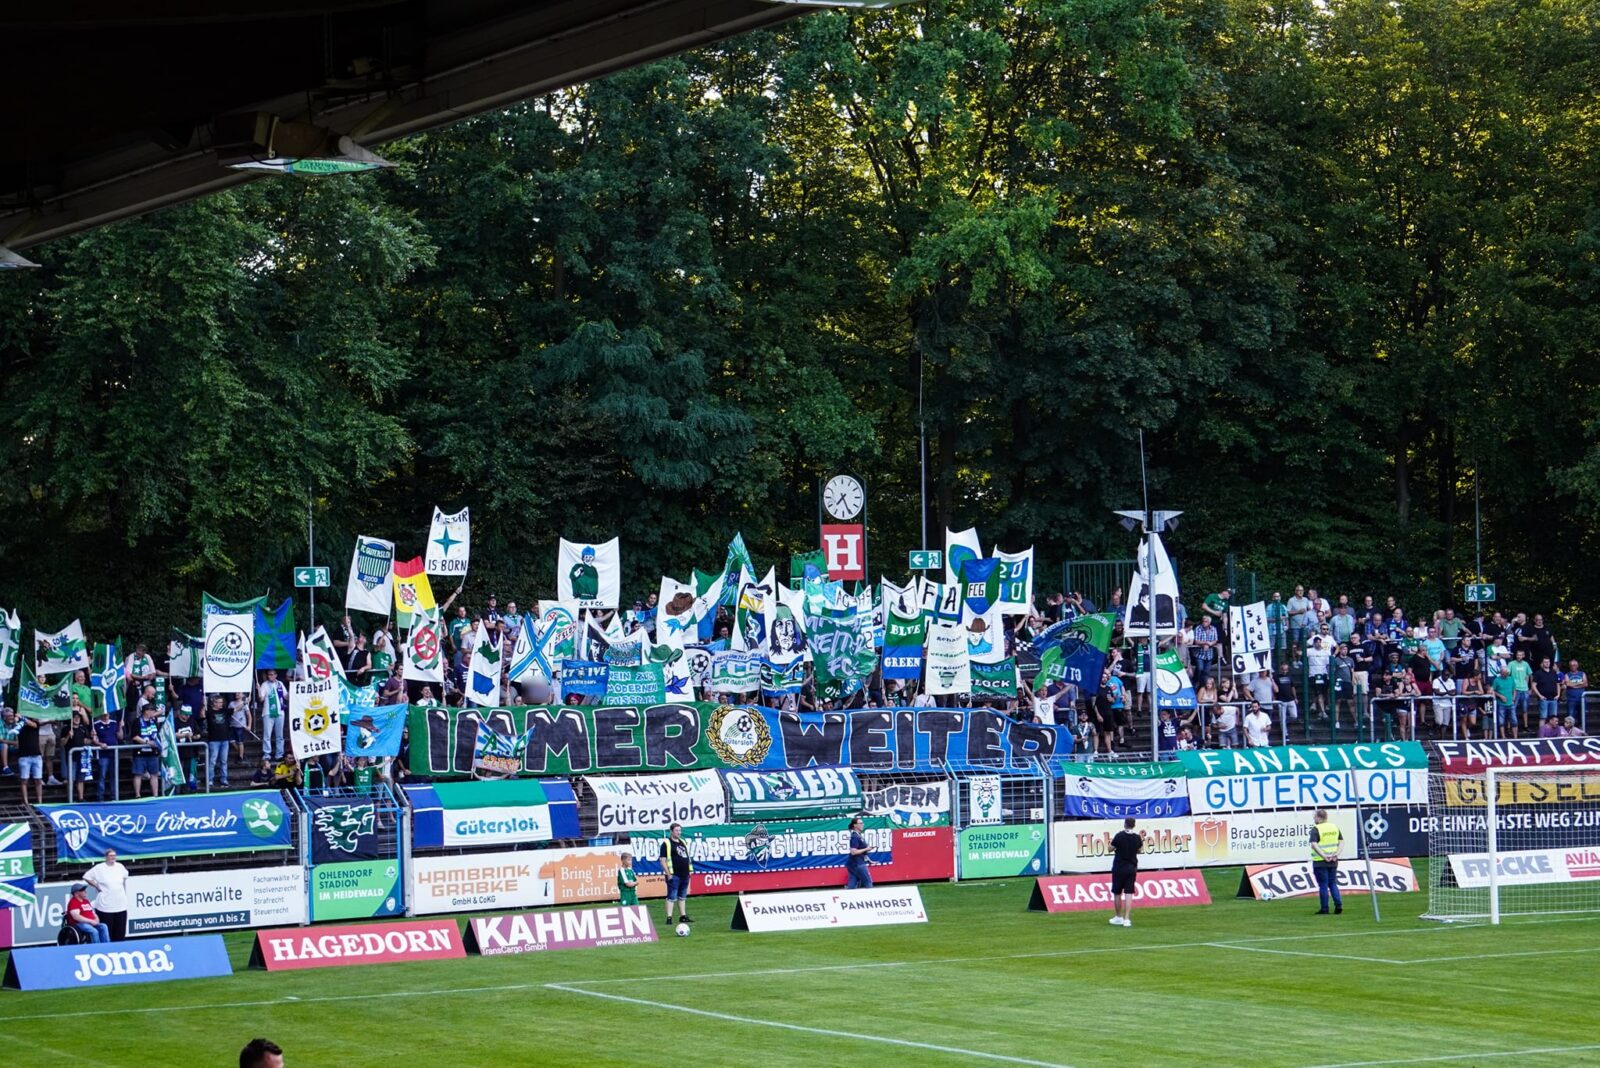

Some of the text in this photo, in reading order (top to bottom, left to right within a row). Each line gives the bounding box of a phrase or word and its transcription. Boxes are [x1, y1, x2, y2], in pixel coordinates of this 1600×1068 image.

[824, 534, 862, 570] H
[428, 559, 467, 572] IS BORN
[968, 584, 984, 596] FCG
[884, 656, 921, 668] GREEN
[426, 705, 1058, 773] IMMER WEITER
[1200, 743, 1406, 775] FANATICS
[1438, 737, 1600, 766] FANATICS
[1085, 764, 1164, 776] Fussball
[624, 780, 692, 796] Aktive
[794, 767, 859, 800] LEBT
[1206, 770, 1410, 809] GÜTERSLOH
[600, 798, 724, 826] Gütersloher
[1082, 802, 1173, 816] Gütersloh
[88, 812, 147, 837] 4830
[156, 809, 238, 833] Gütersloh
[456, 816, 539, 836] Gütersloh
[1410, 816, 1438, 833] DER
[1442, 814, 1532, 832] EINFAHSTE
[1535, 812, 1570, 828] WEG
[968, 832, 1020, 842] OHLENDORF
[1231, 824, 1315, 840] BrauSpezialitä
[630, 829, 892, 862] VOÄRTS GÜTERSOH
[968, 840, 1006, 850] STADION
[1231, 840, 1296, 850] Privat-Brauerei
[968, 849, 1030, 860] IM HEIDEWALD
[318, 868, 373, 880] OHLENDORF
[418, 865, 530, 884] HAMBRINK
[704, 874, 732, 886] GWG
[1258, 866, 1408, 898] Kleiemas
[318, 878, 359, 890] STADION
[432, 880, 518, 897] GRABKE
[562, 886, 573, 898] in
[577, 884, 600, 896] dein
[136, 886, 242, 909] Rechtsanwälte
[318, 888, 384, 900] IM HEIDEWALD
[452, 898, 472, 906] GmbH
[20, 893, 72, 929] We
[754, 902, 826, 915] PANNHORST
[841, 898, 912, 910] PANNHORST
[134, 914, 246, 930] Insolvenzberatung von A bis Z
[476, 905, 651, 948] KAHMEN
[268, 928, 452, 961] HAGEDORN
[482, 942, 547, 955] TransCargo GmbH
[596, 936, 652, 946] www.kahmen.de
